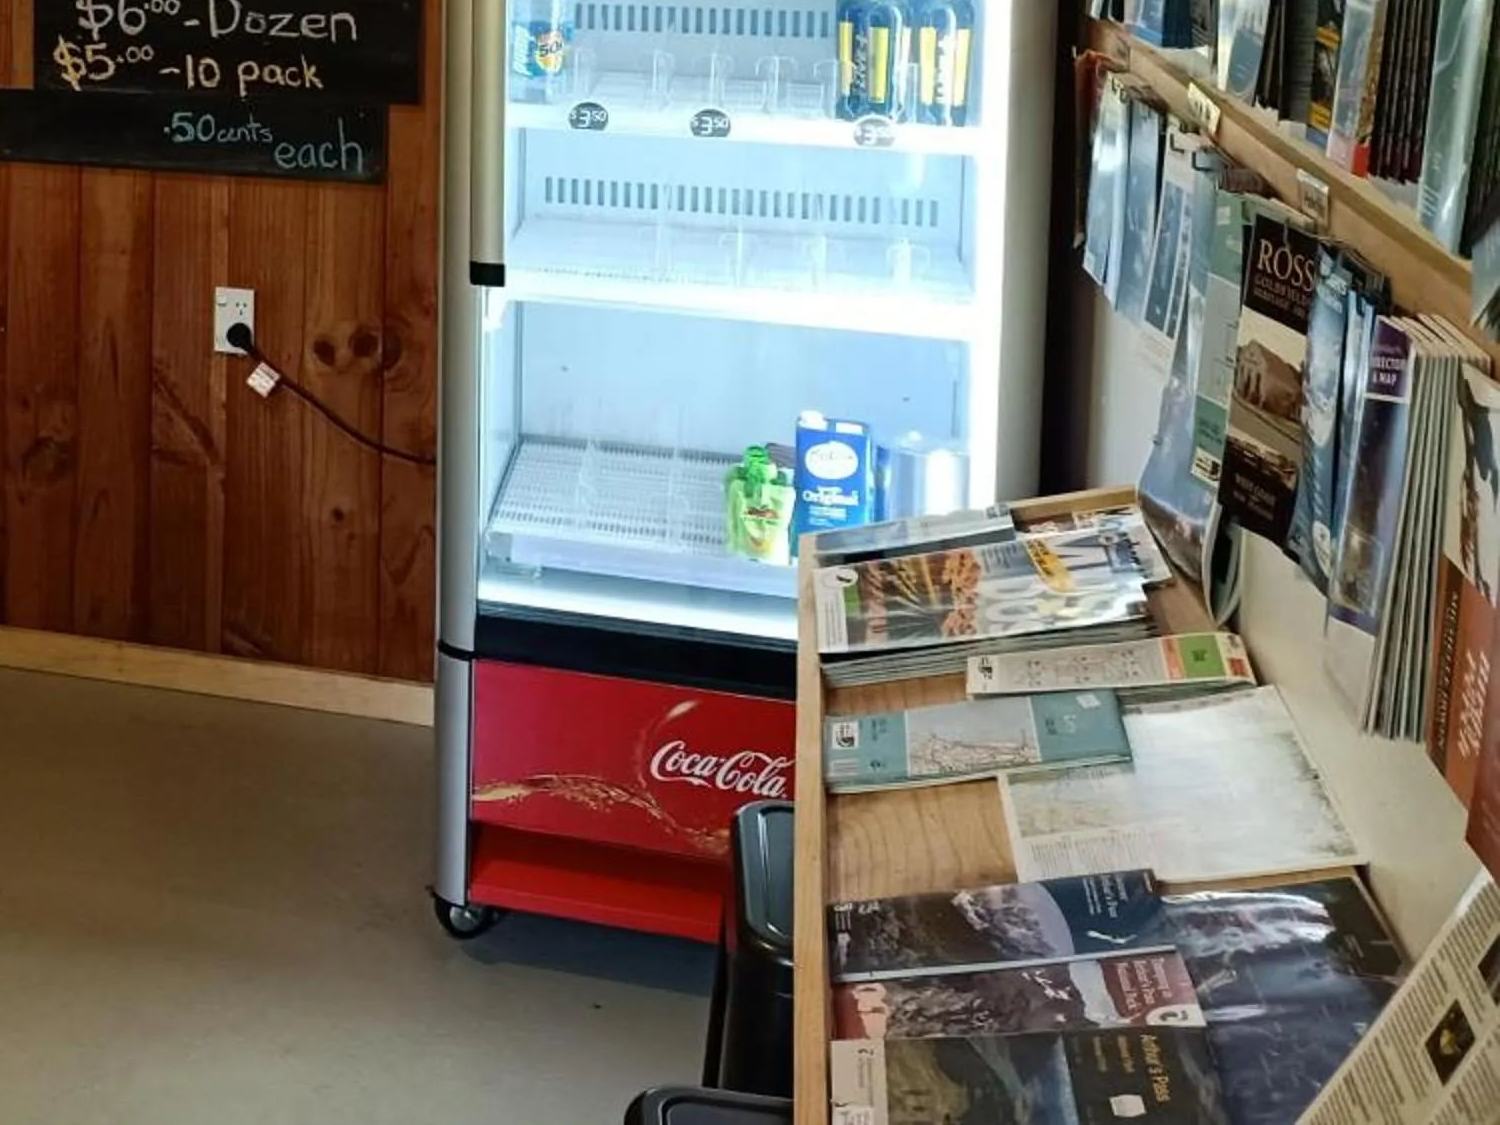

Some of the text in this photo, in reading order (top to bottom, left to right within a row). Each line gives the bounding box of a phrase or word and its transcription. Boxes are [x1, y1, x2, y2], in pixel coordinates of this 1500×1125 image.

[237, 55, 323, 97] pack
[275, 117, 363, 173] each
[1257, 238, 1316, 293] ROSS
[651, 740, 794, 798] Coca-Cola
[1150, 1076, 1171, 1104] Pass
